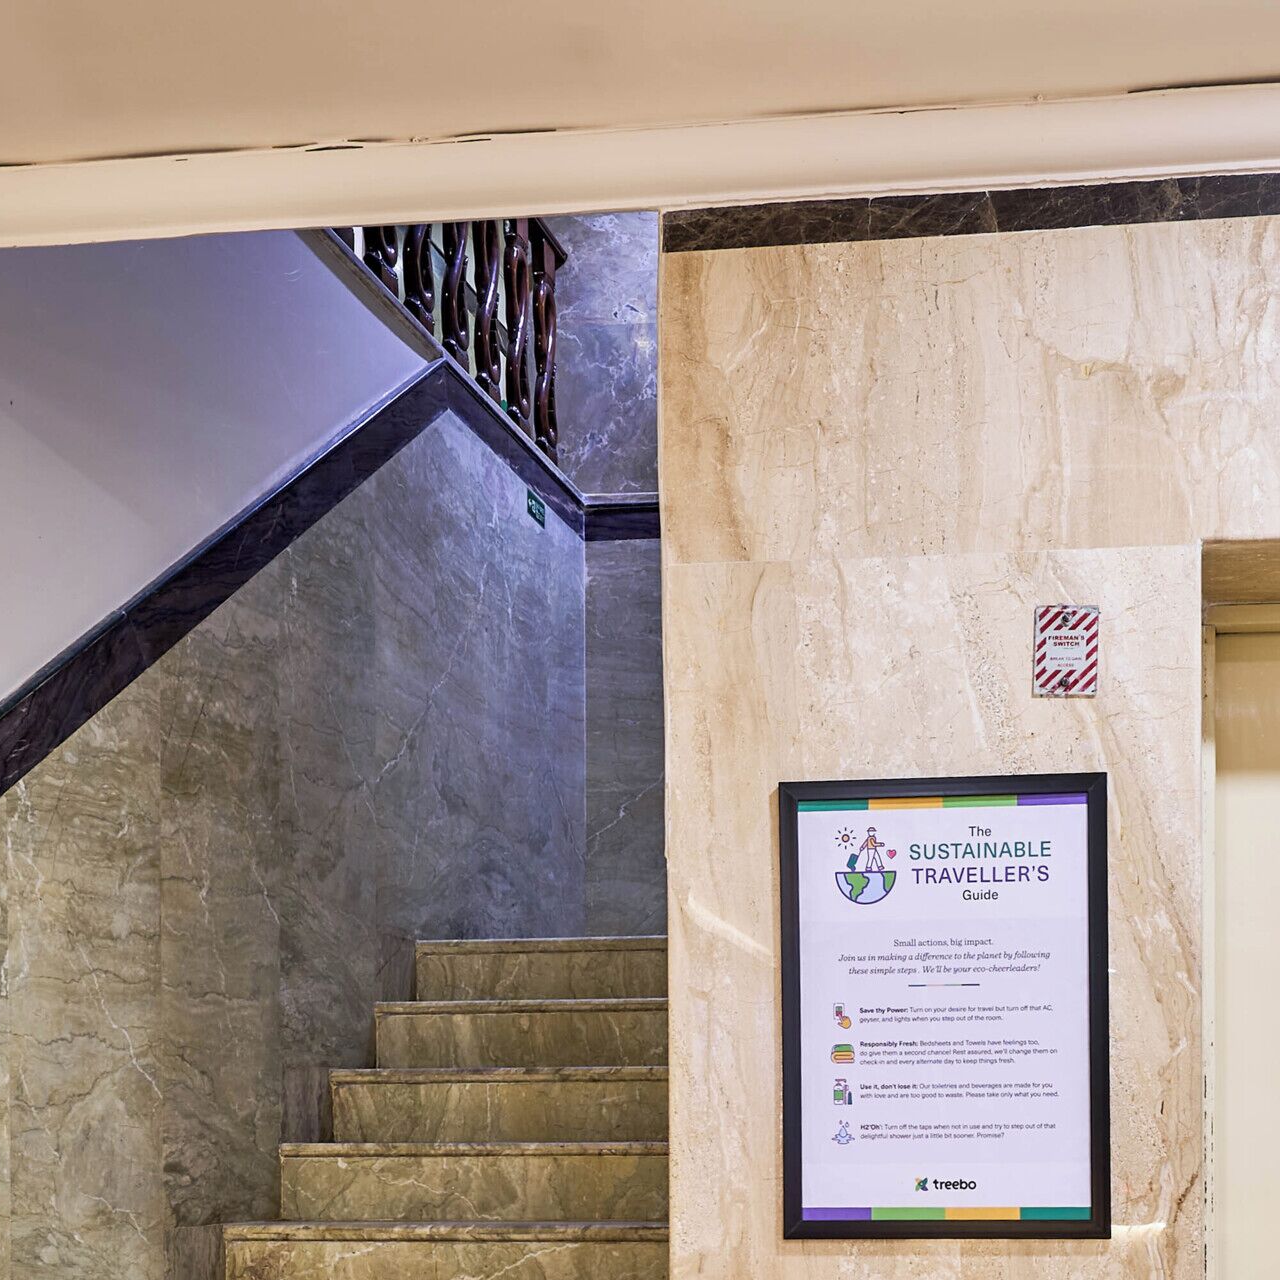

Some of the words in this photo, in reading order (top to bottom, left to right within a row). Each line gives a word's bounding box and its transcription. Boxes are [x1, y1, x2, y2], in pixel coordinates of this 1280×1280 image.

[968, 826, 992, 836] The
[909, 840, 1052, 860] SUSTAINABLE
[912, 865, 1050, 884] TRAVELLER'S
[962, 889, 999, 900] Guide
[918, 938, 949, 948] actions,
[951, 938, 962, 948] big
[964, 938, 994, 947] impact.
[838, 954, 856, 962] Join
[878, 953, 907, 963] making
[915, 953, 952, 962] difference
[954, 952, 962, 960] to
[963, 952, 975, 960] the
[977, 952, 1002, 961] planet
[1003, 951, 1013, 961] by
[1014, 951, 1050, 960] following
[849, 967, 868, 975] these
[870, 967, 895, 976] simple
[944, 965, 951, 973] be
[953, 966, 971, 975] your
[973, 964, 1041, 972] eco-cheerleaders!
[876, 1007, 885, 1015] thy
[1043, 1005, 1053, 1013] AC,
[942, 1015, 955, 1023] step
[860, 1041, 897, 1049] Responsibly
[1003, 1039, 1027, 1047] feelings
[1028, 1039, 1039, 1047] too,
[869, 1050, 881, 1058] give
[1009, 1048, 1031, 1056] change
[944, 1058, 954, 1066] day
[963, 1058, 977, 1066] keep
[979, 1057, 997, 1065] things
[972, 1082, 1002, 1090] beverages
[1001, 1091, 1013, 1099] only
[995, 1123, 1004, 1131] try
[1012, 1123, 1024, 1131] step
[861, 1133, 888, 1141] delightful
[913, 1133, 924, 1141] just
[933, 1178, 977, 1190] treebo
